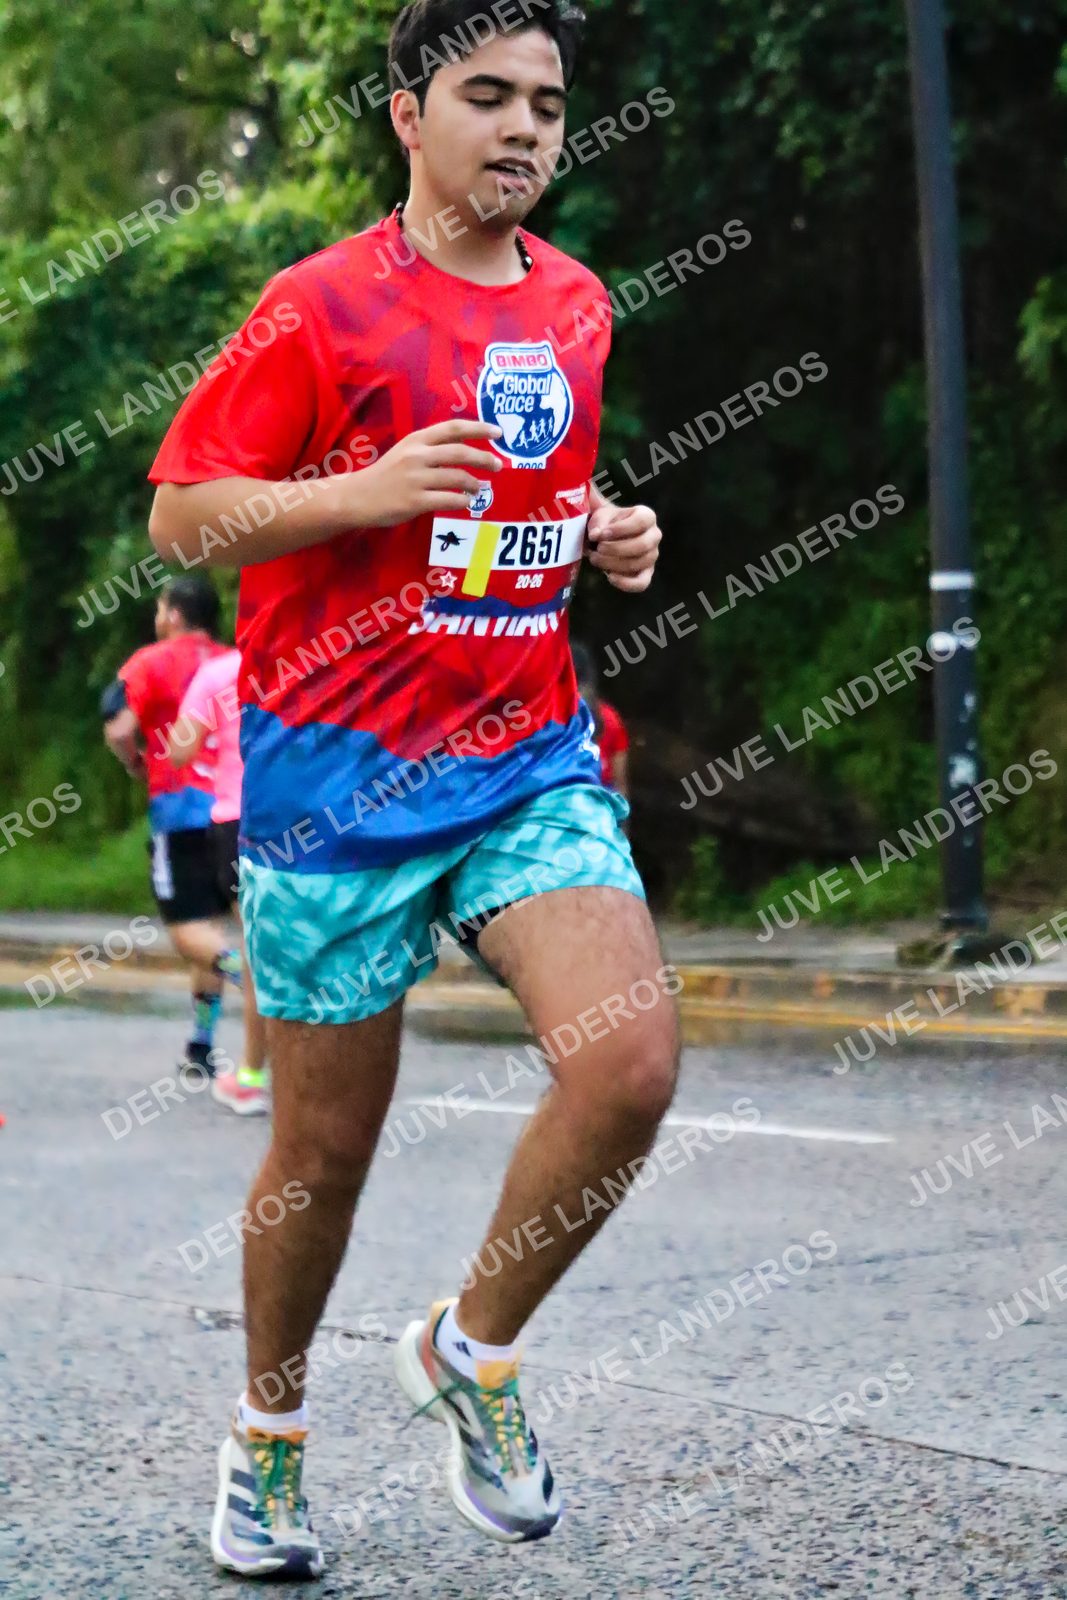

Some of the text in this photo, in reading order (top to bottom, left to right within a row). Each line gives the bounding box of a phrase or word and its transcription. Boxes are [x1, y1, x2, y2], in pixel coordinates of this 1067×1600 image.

[495, 354, 548, 368] BIMBO
[503, 374, 551, 395] Global
[493, 395, 535, 414] Race
[498, 524, 563, 567] 2651
